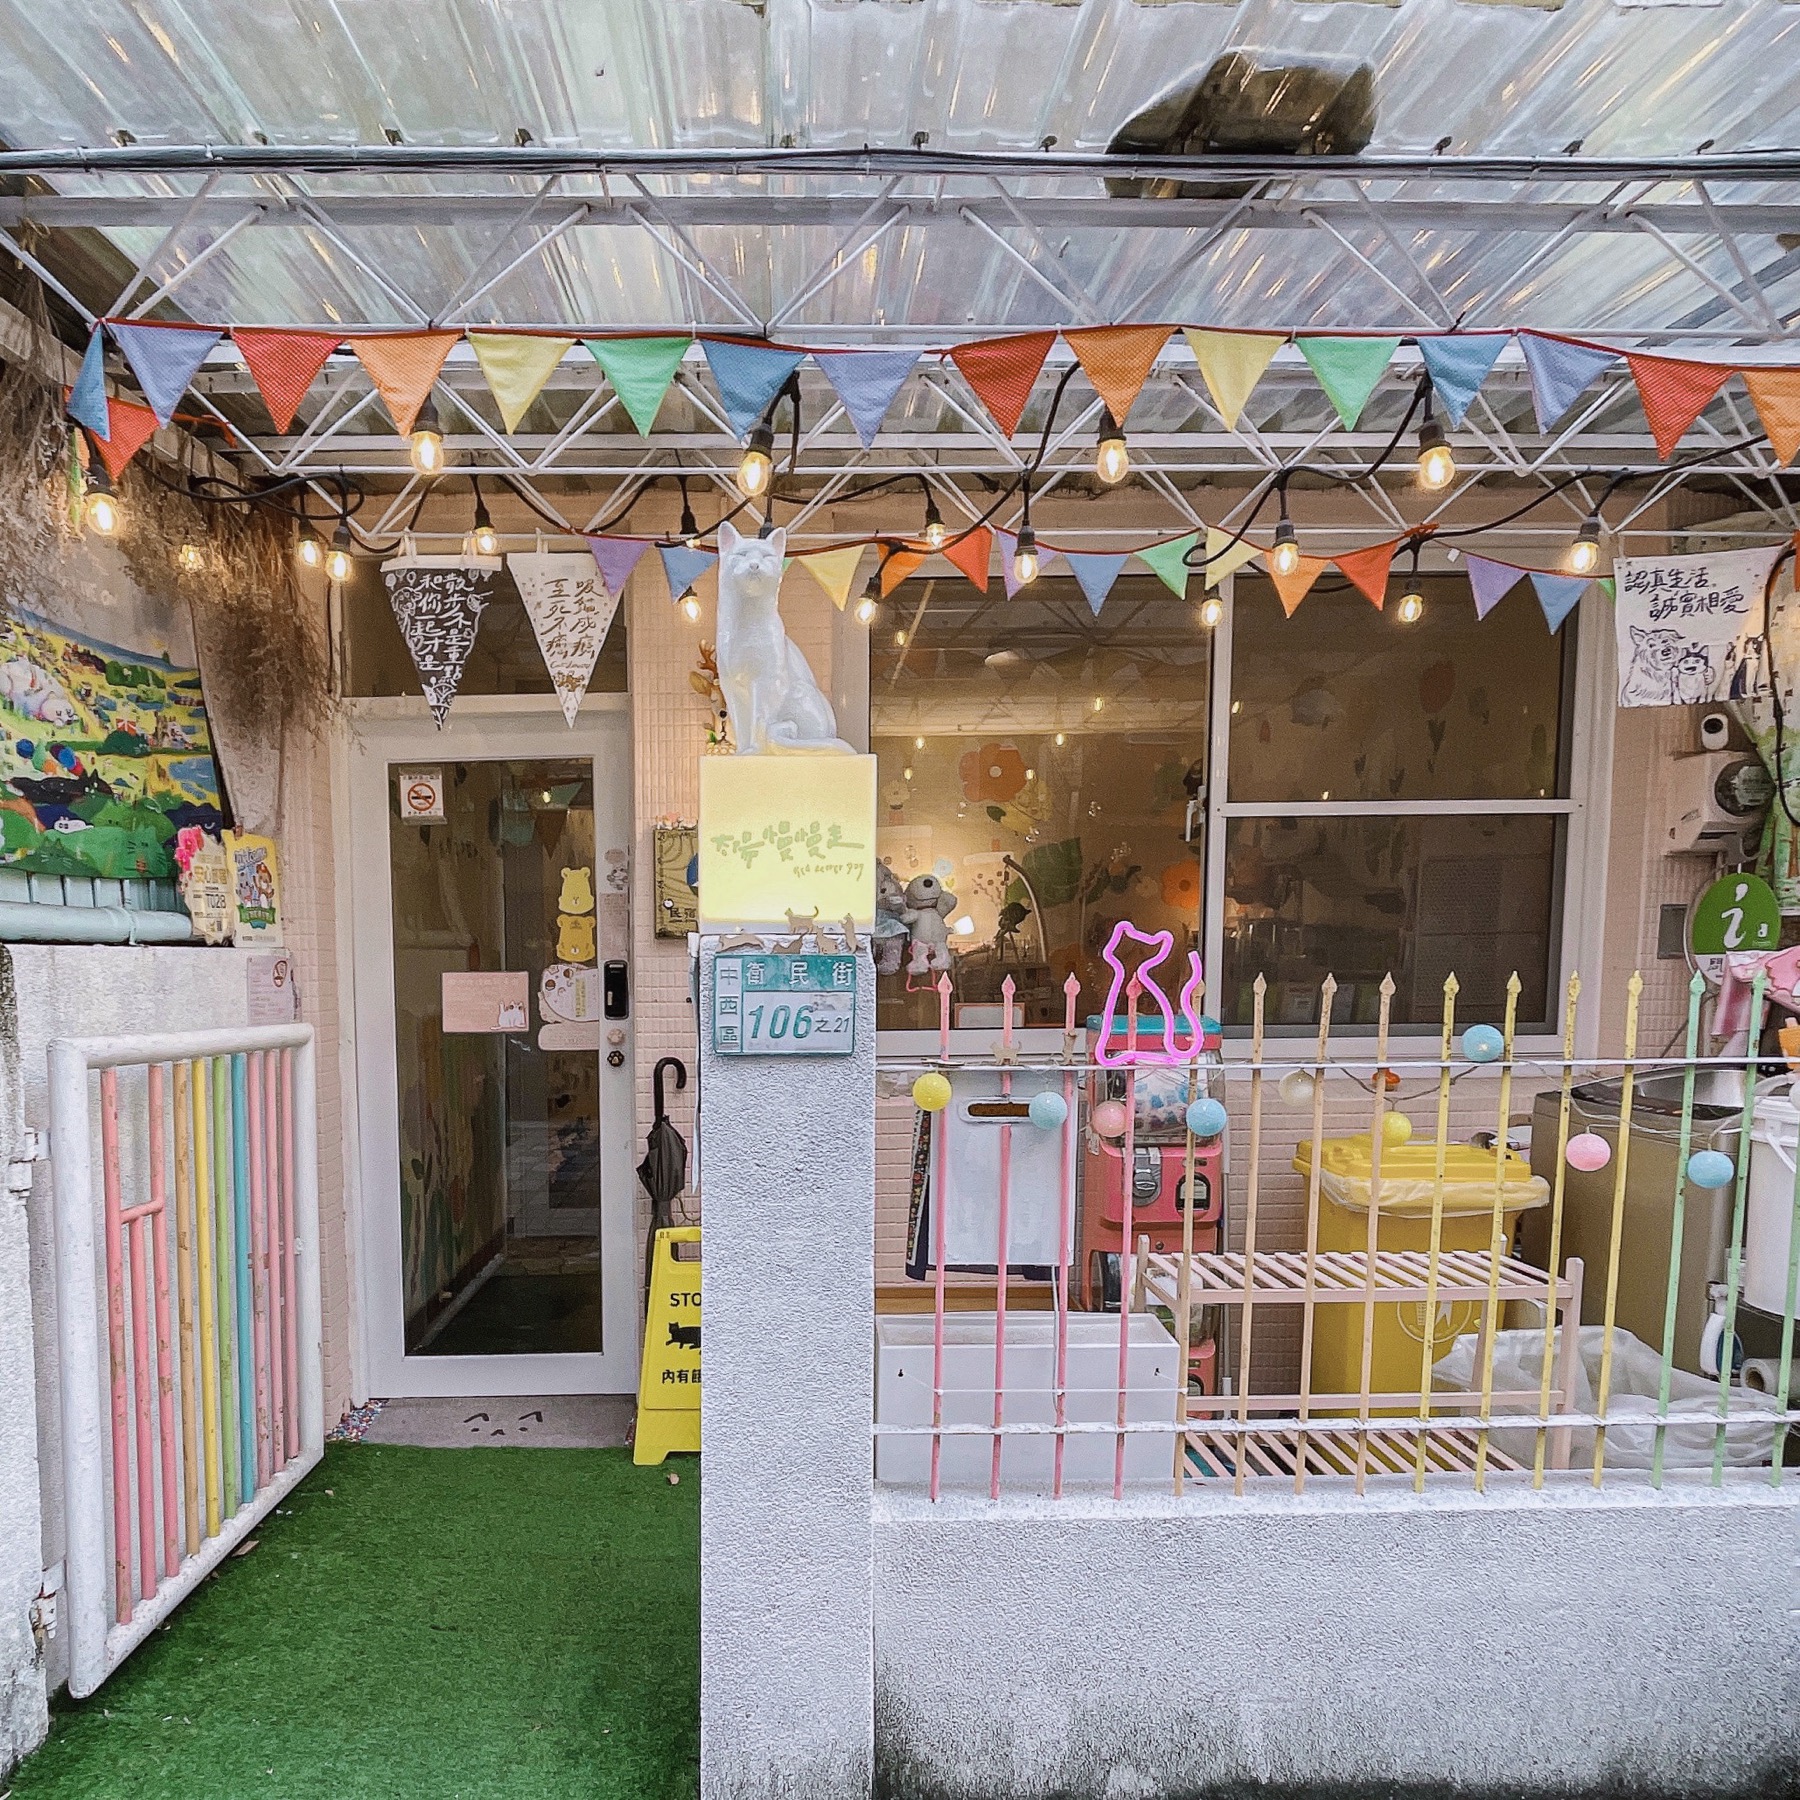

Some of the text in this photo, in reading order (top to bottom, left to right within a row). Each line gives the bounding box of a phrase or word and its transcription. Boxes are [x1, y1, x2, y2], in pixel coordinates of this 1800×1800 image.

[1624, 566, 1710, 595] 認真生活
[1649, 586, 1750, 621] 誠實相愛
[411, 574, 446, 671] 和你一起才是
[439, 572, 475, 686] 散步不是重點
[746, 961, 853, 986] 衛民街
[719, 966, 739, 1047] 中西區
